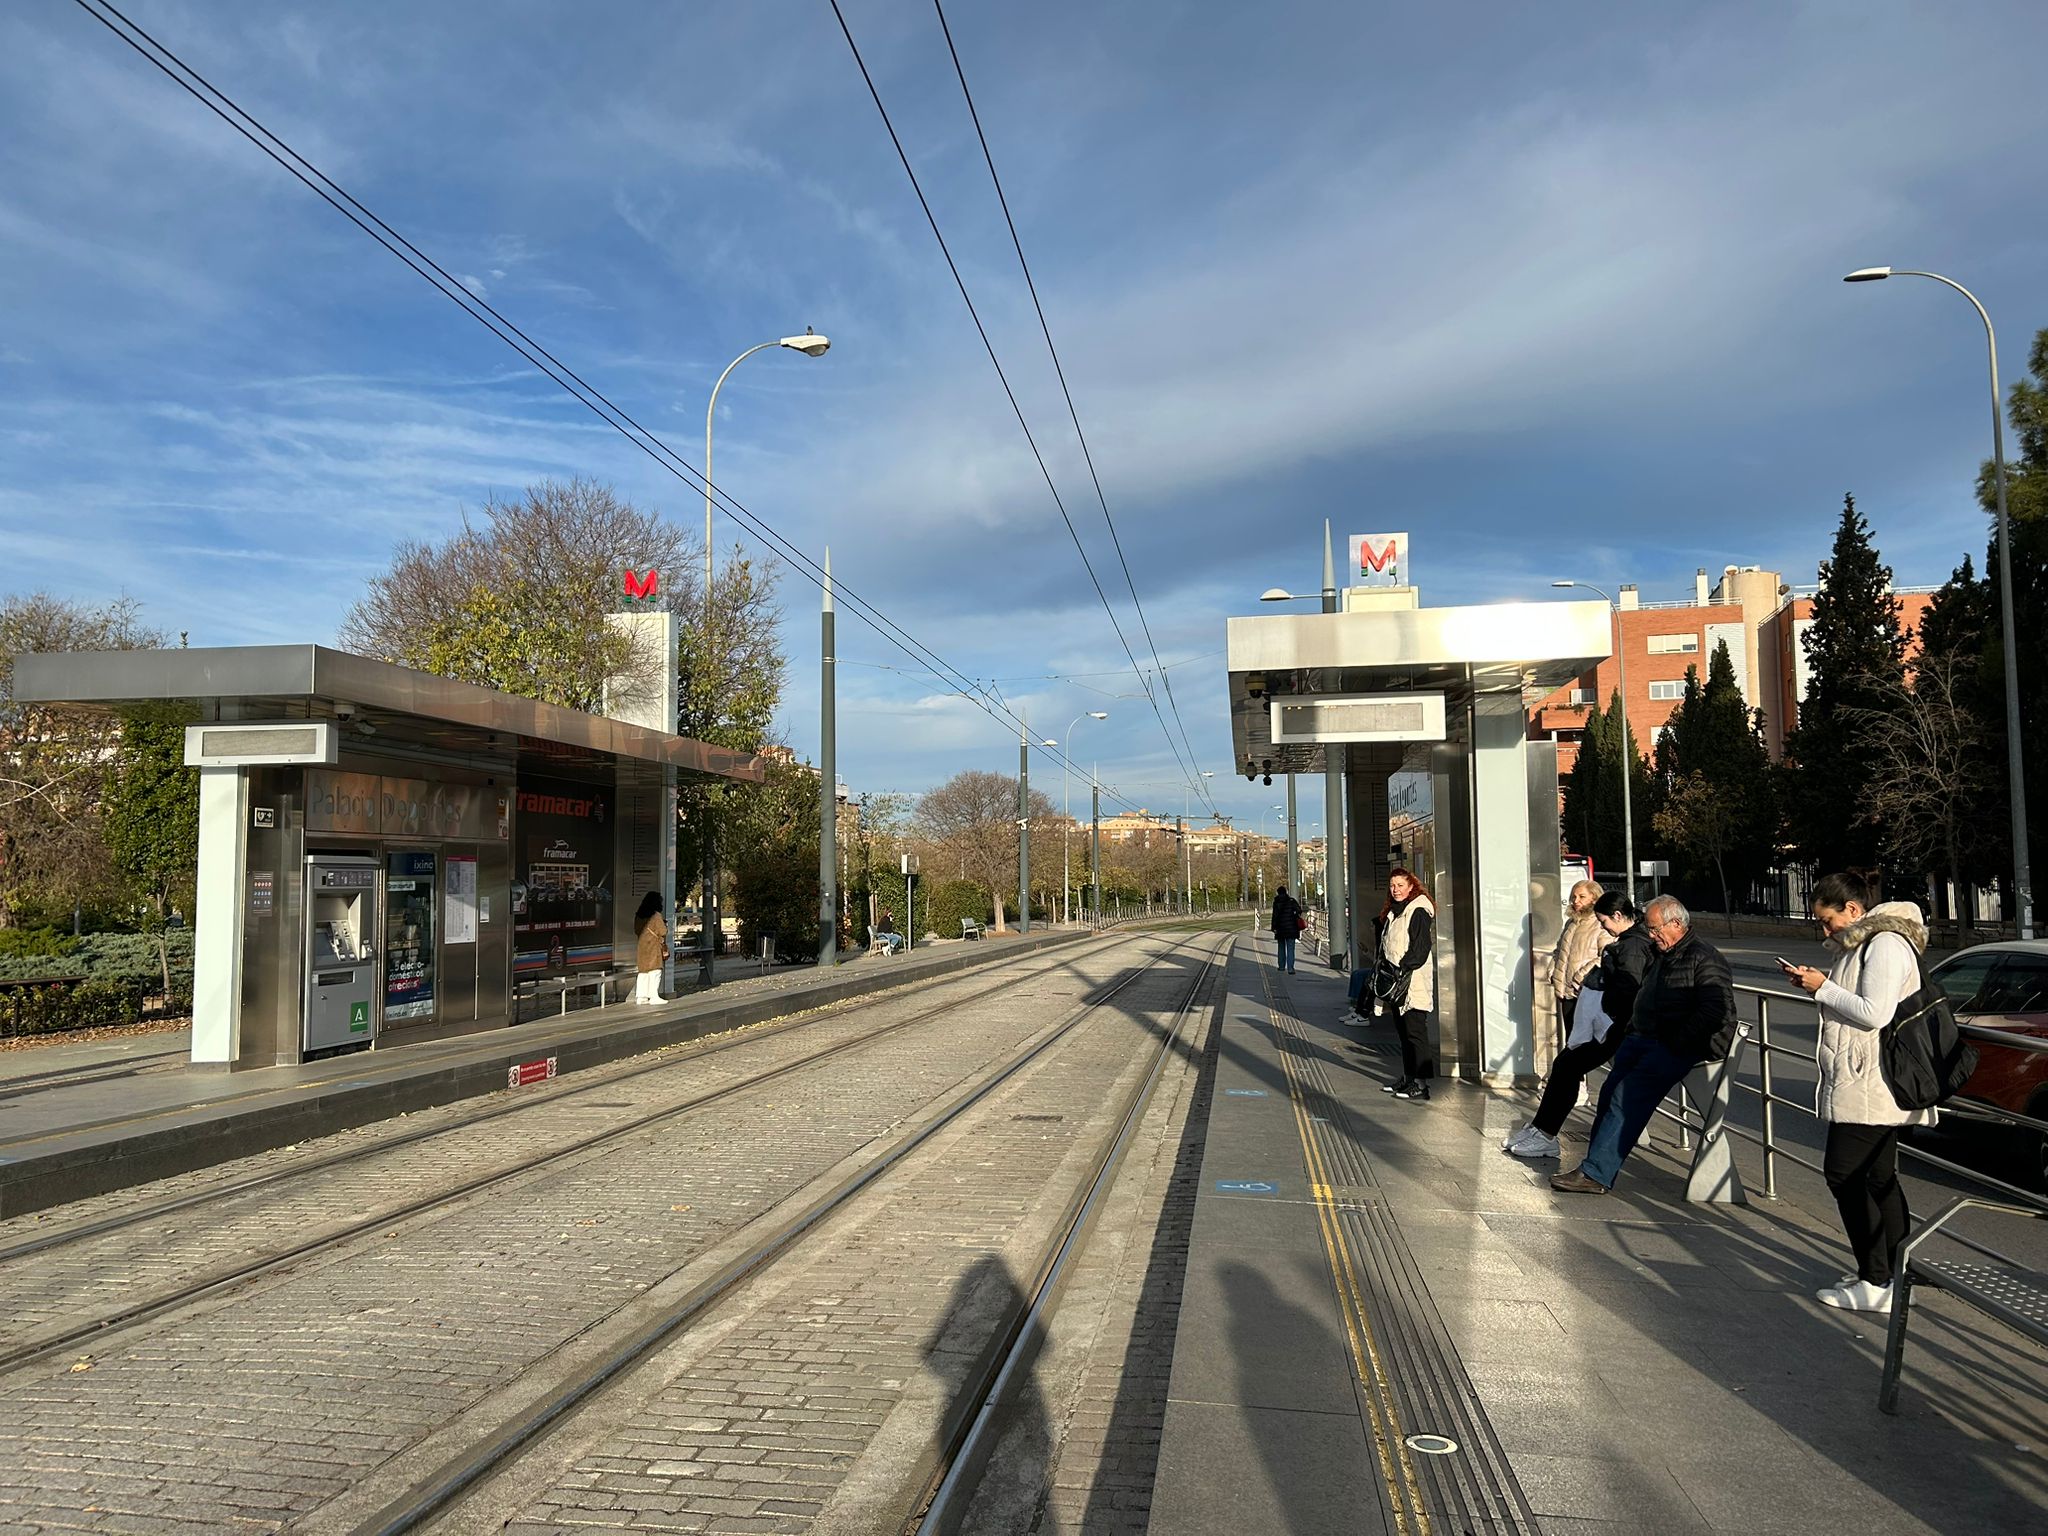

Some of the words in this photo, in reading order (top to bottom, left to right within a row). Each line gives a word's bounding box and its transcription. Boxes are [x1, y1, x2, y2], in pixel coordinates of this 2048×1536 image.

[1361, 540, 1396, 576] M
[624, 569, 657, 603] M
[516, 792, 593, 817] ramacar
[544, 848, 577, 859] framacar
